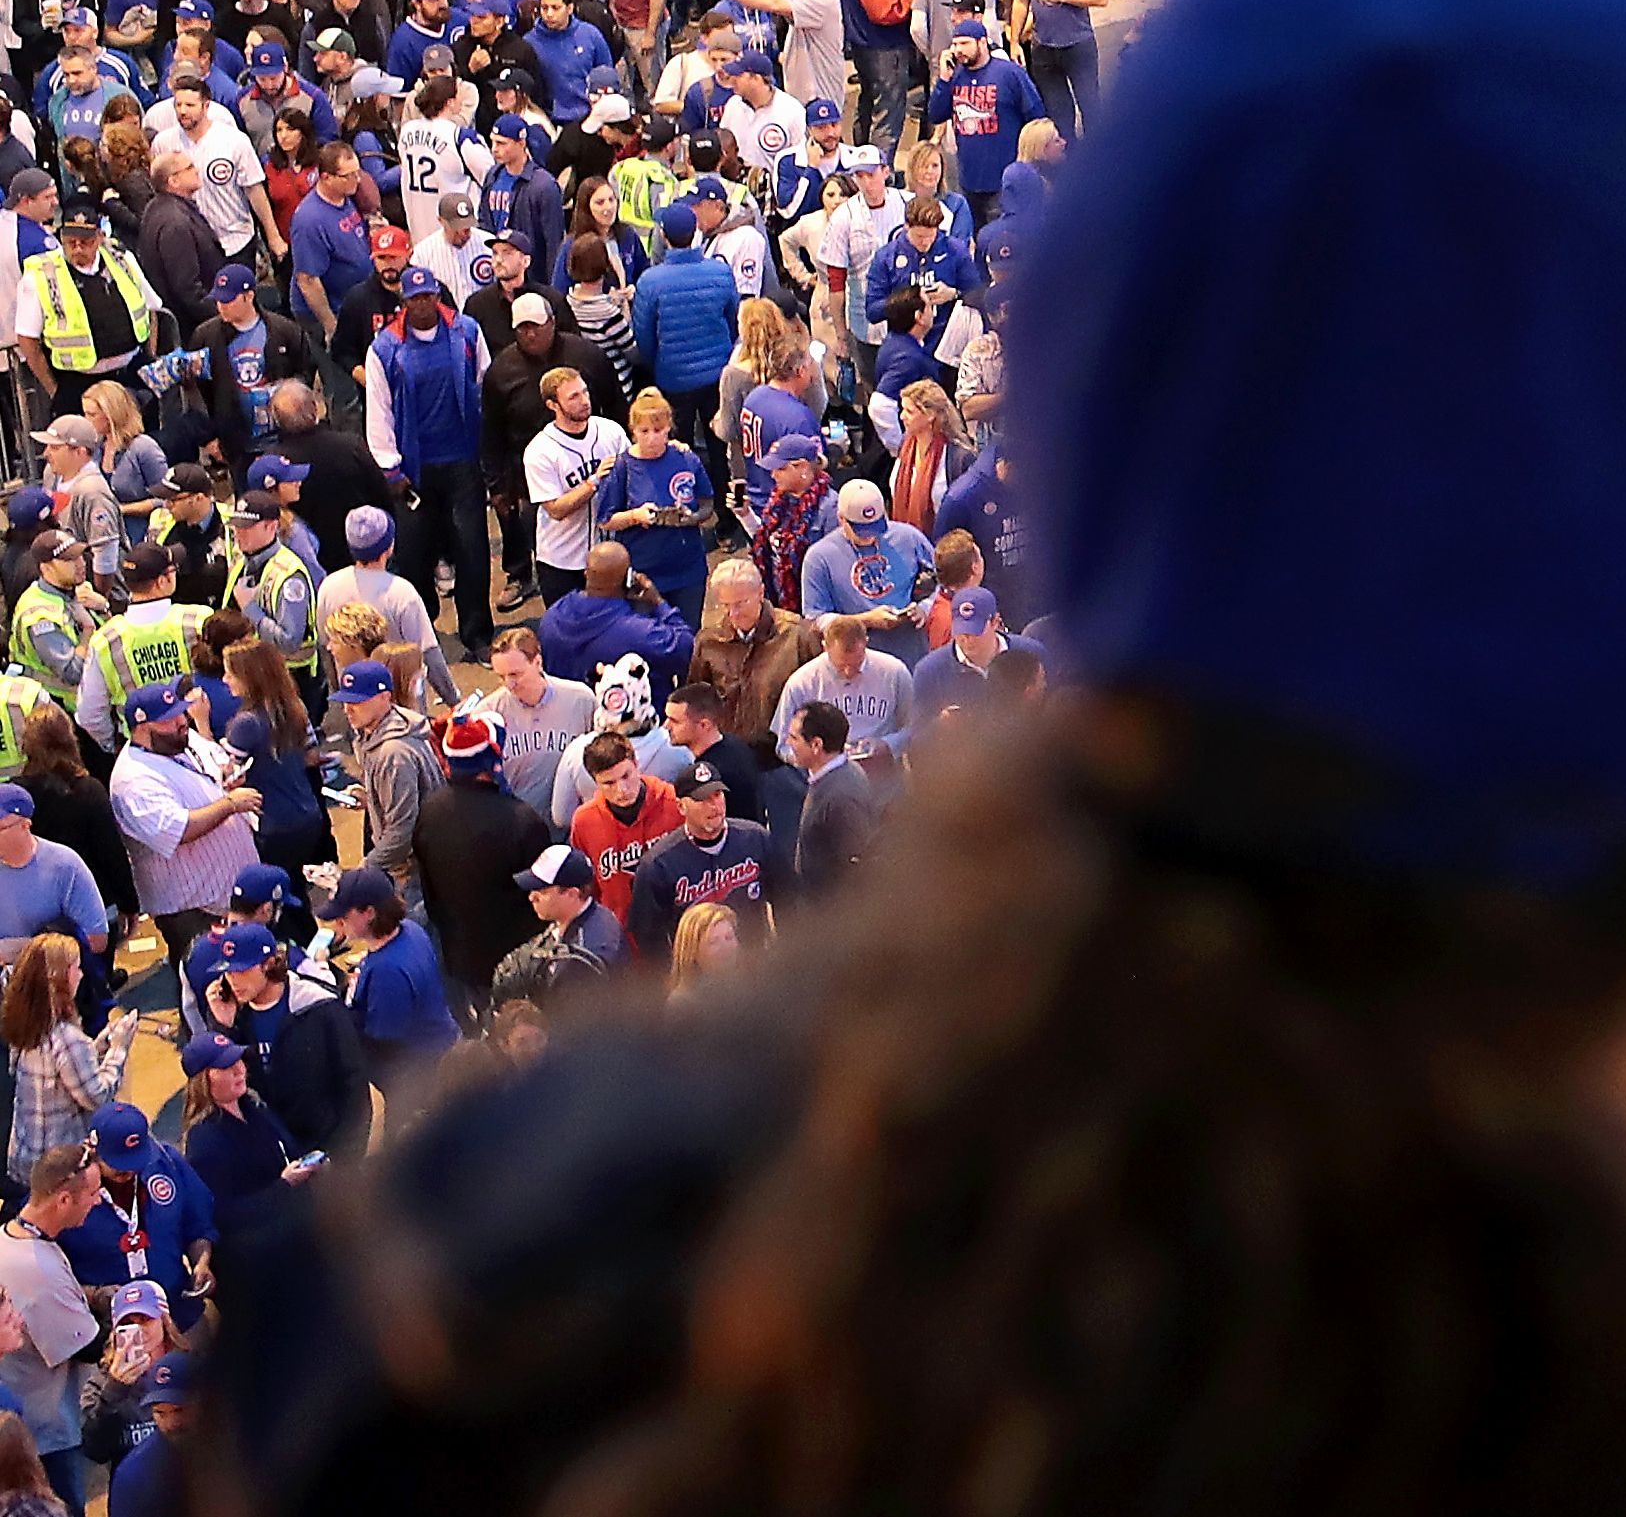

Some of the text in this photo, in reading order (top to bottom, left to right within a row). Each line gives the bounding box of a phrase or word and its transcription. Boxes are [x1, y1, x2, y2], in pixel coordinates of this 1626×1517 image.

[401, 130, 447, 155] SORIANO
[406, 153, 439, 194] 12
[565, 458, 602, 489] CUB
[132, 641, 179, 666] CHICAGO
[138, 660, 183, 684] POLICE
[835, 695, 888, 719] ICAGO
[502, 730, 577, 761] HICAG
[674, 856, 760, 907] Indians
